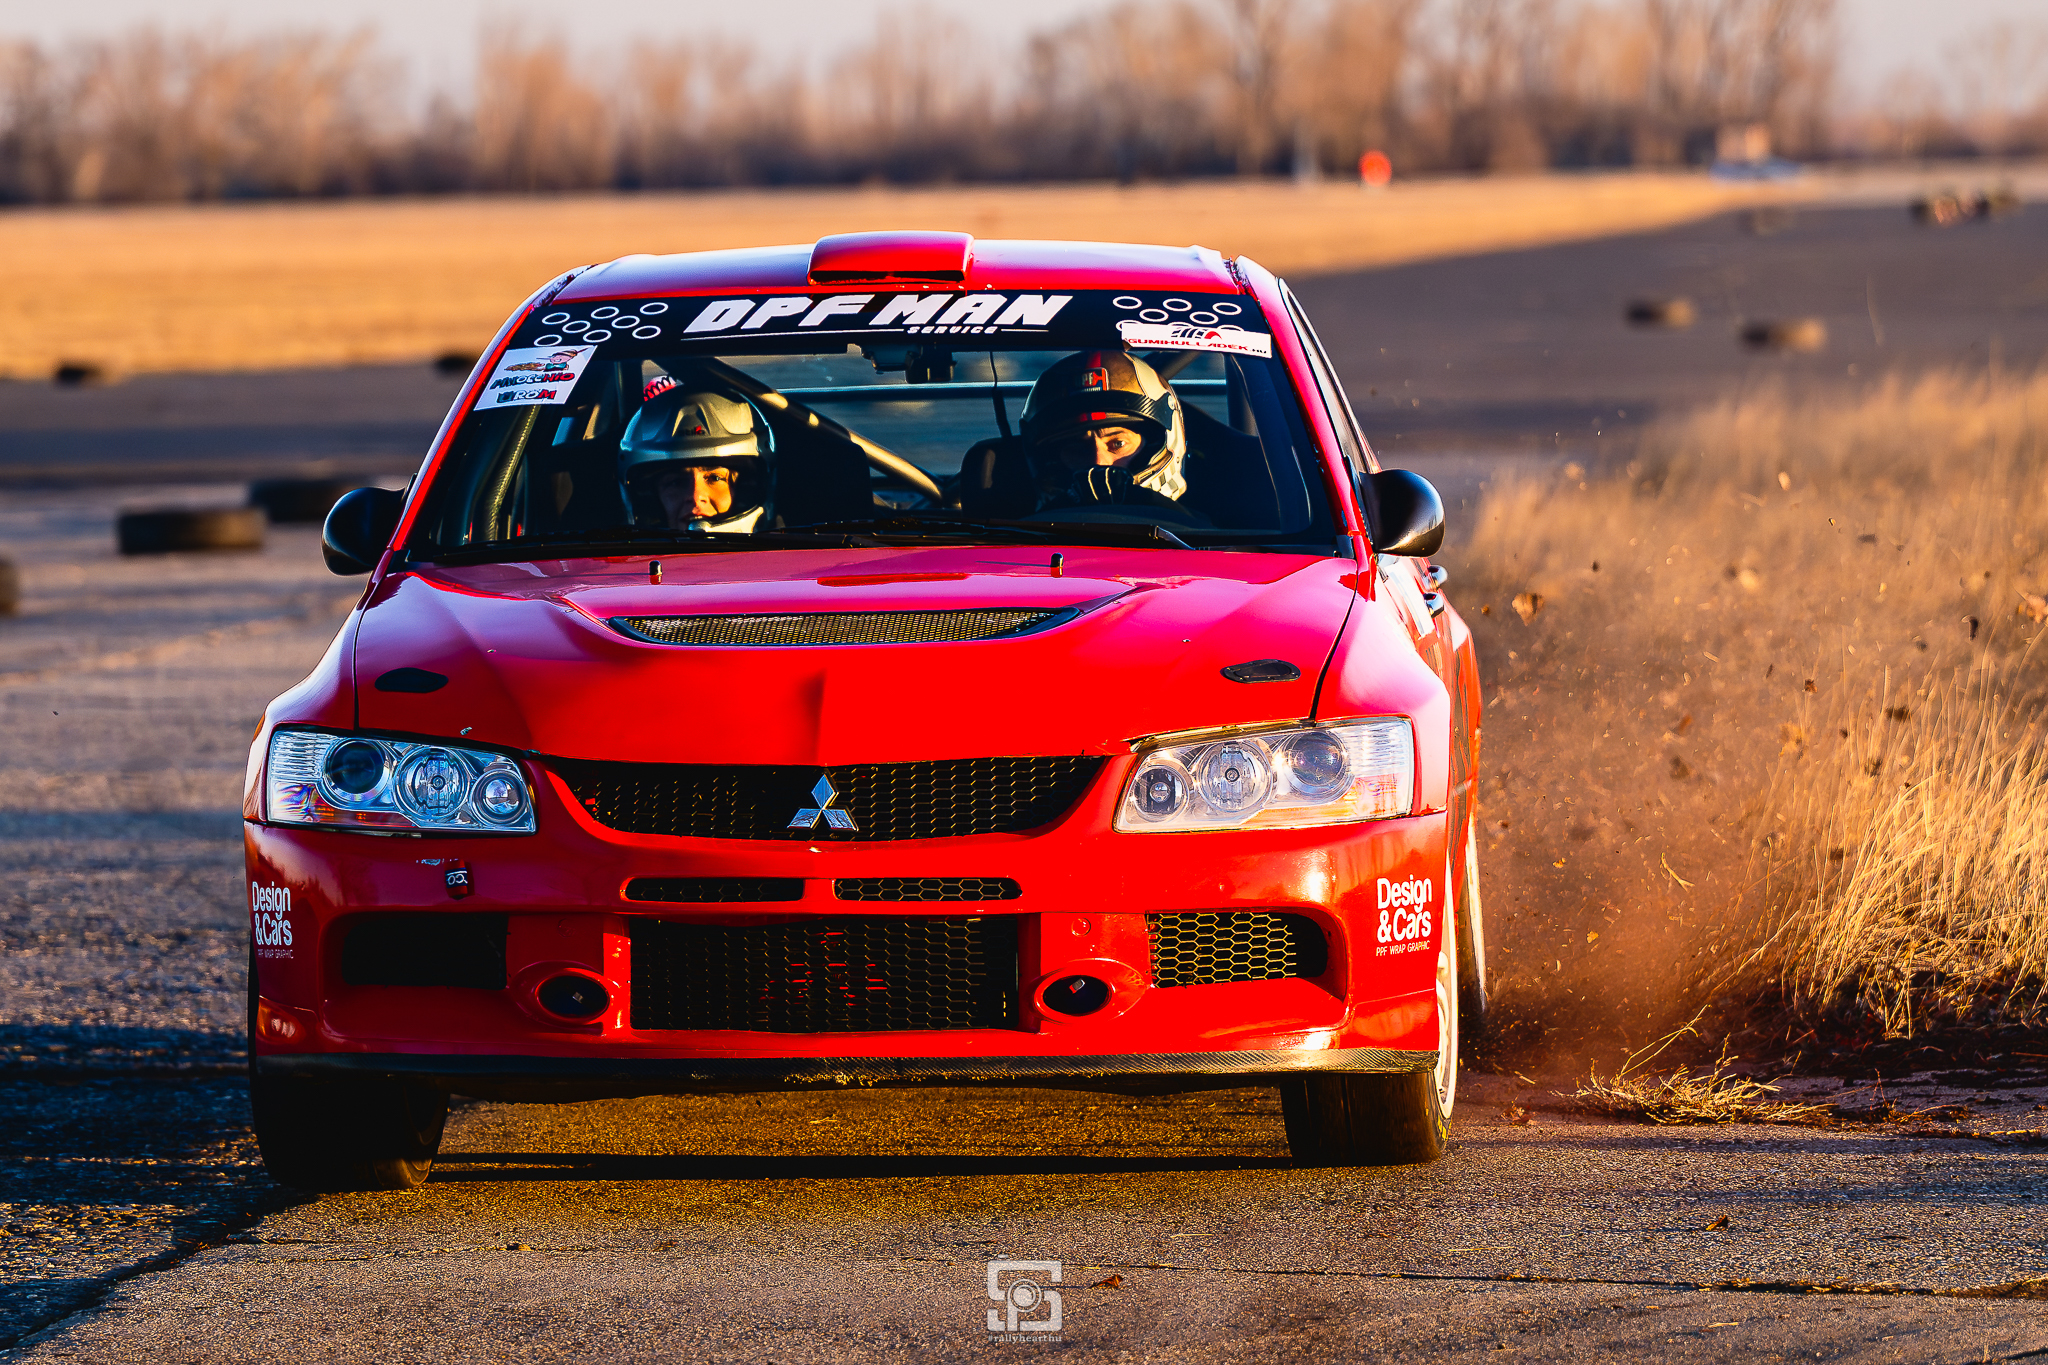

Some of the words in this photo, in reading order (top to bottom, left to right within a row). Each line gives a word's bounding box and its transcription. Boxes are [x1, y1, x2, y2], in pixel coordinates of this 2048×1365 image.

[684, 294, 875, 333] DPF
[869, 294, 1073, 326] MAN
[906, 325, 998, 334] SERVICE
[252, 881, 291, 920] Design
[1376, 874, 1432, 913] Design
[254, 912, 293, 946] &Cars
[1377, 907, 1432, 943] &Cars
[1376, 945, 1388, 957] PPF
[1389, 943, 1406, 955] WRAP
[1407, 940, 1431, 953] GRAPHIC
